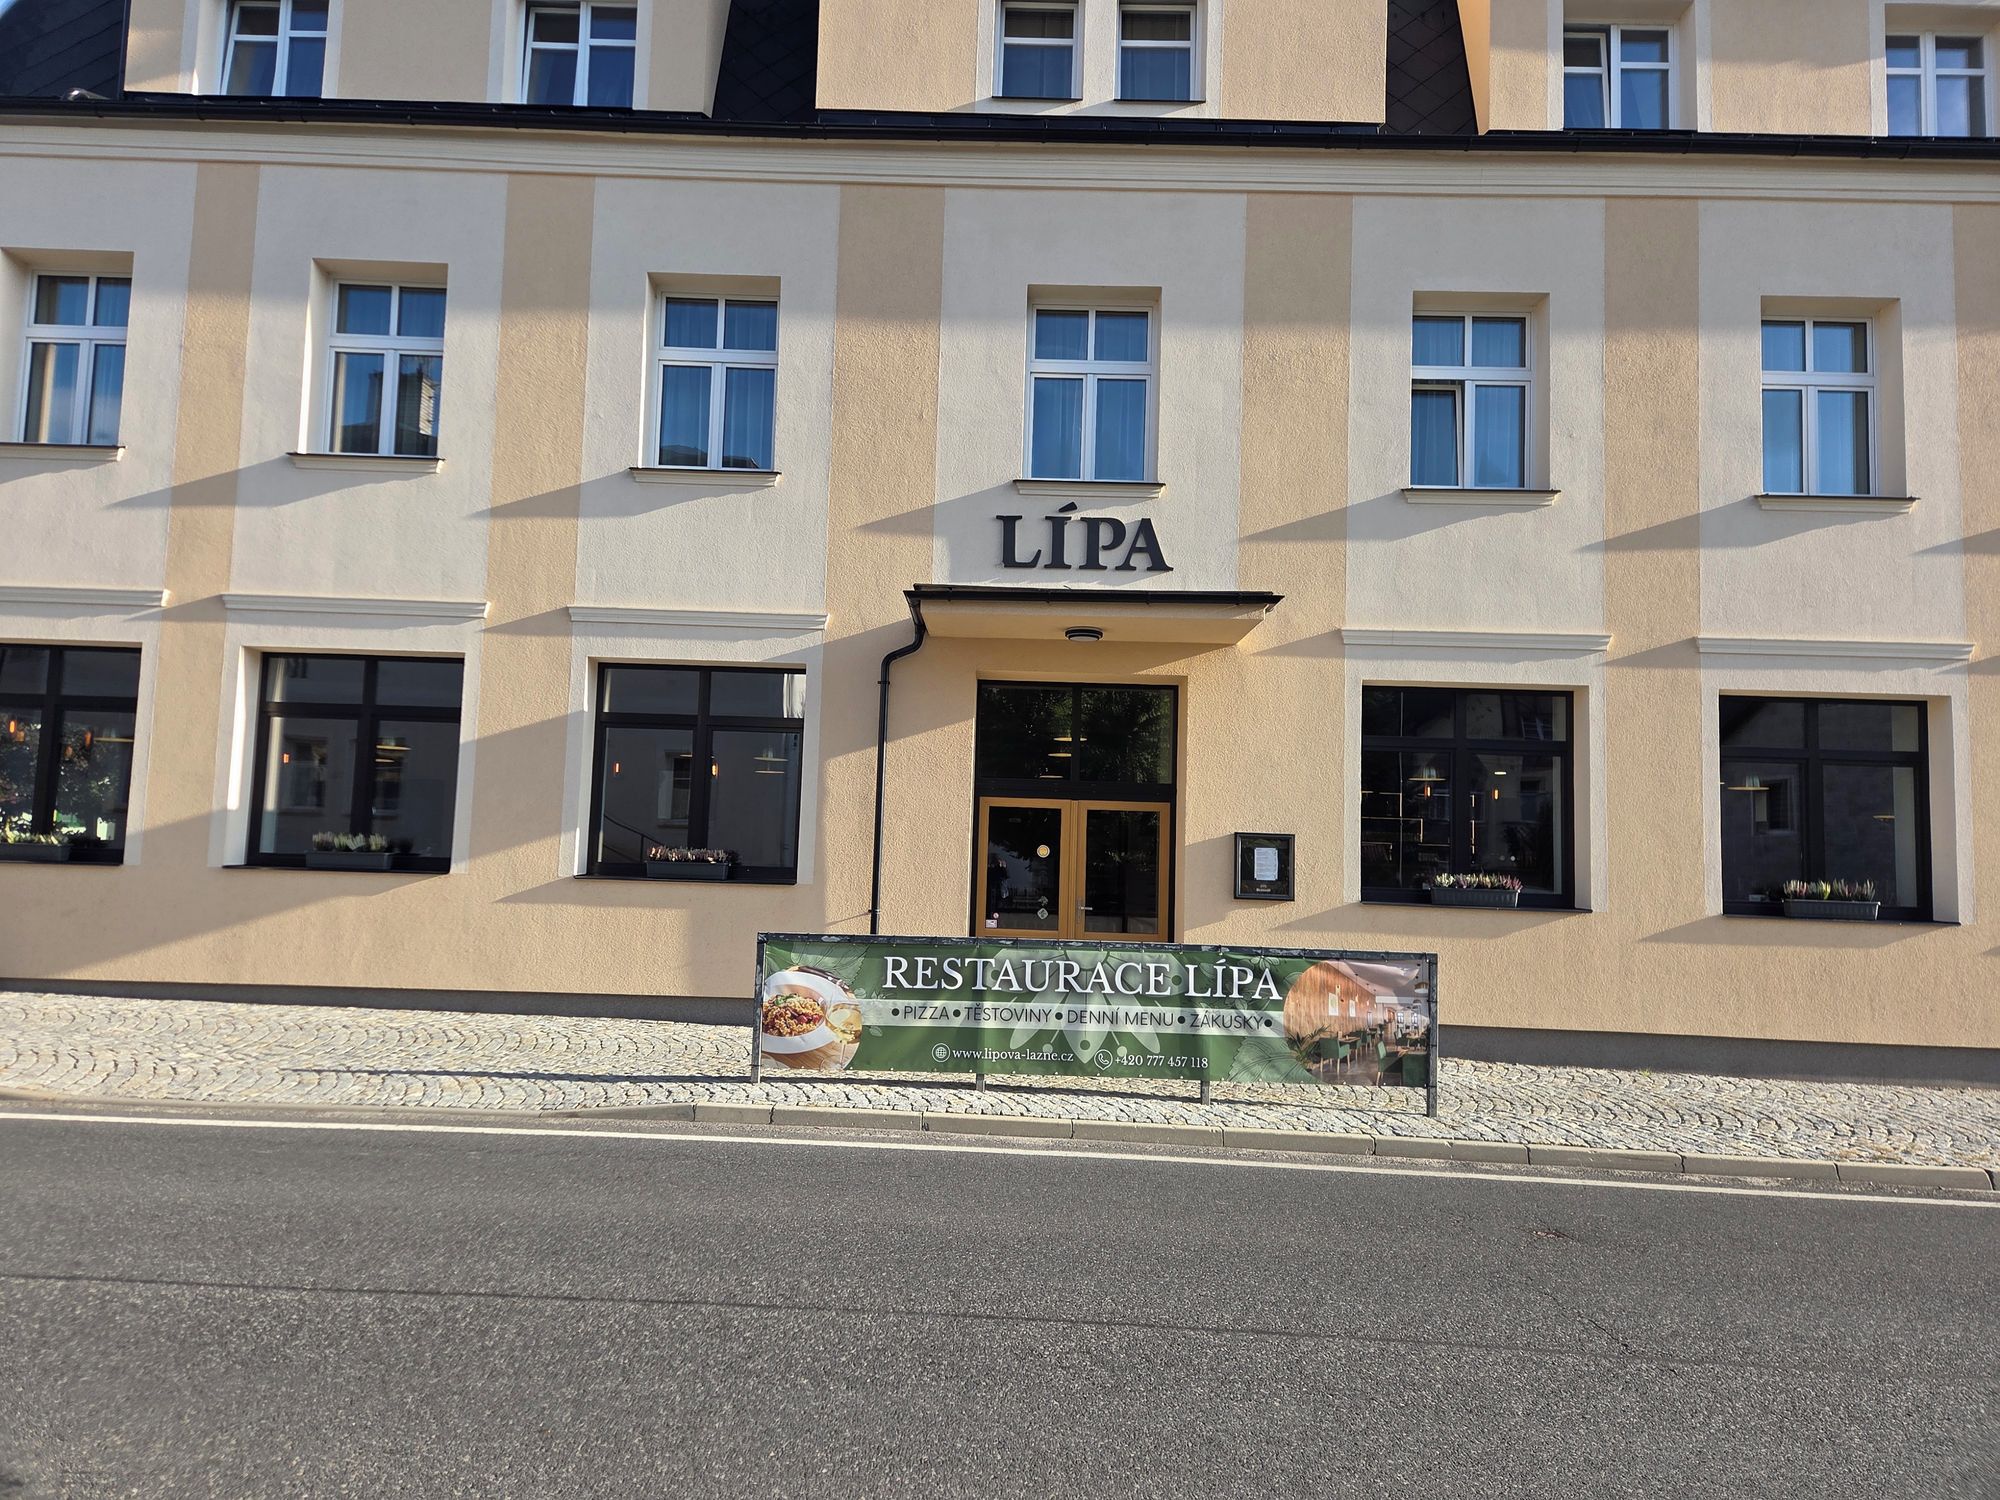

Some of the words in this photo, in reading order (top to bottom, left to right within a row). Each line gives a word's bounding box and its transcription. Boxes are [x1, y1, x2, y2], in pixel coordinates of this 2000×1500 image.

[995, 501, 1174, 572] LÍPA
[882, 956, 1171, 996] RESTAURACE
[1184, 959, 1283, 1000] LÍPA
[903, 1005, 949, 1021] PIZZA
[964, 1003, 1052, 1023] TĚSTOVINY
[1067, 1007, 1120, 1025] DENNÍ
[1124, 1010, 1174, 1027] MENU
[1190, 1010, 1264, 1030] ZÁKUSKY
[952, 1047, 1074, 1063] www.lipova-lazne.cz
[1115, 1054, 1143, 1066] +420
[1147, 1054, 1165, 1067] 777
[1167, 1056, 1188, 1067] 457
[1190, 1056, 1209, 1068] 118
